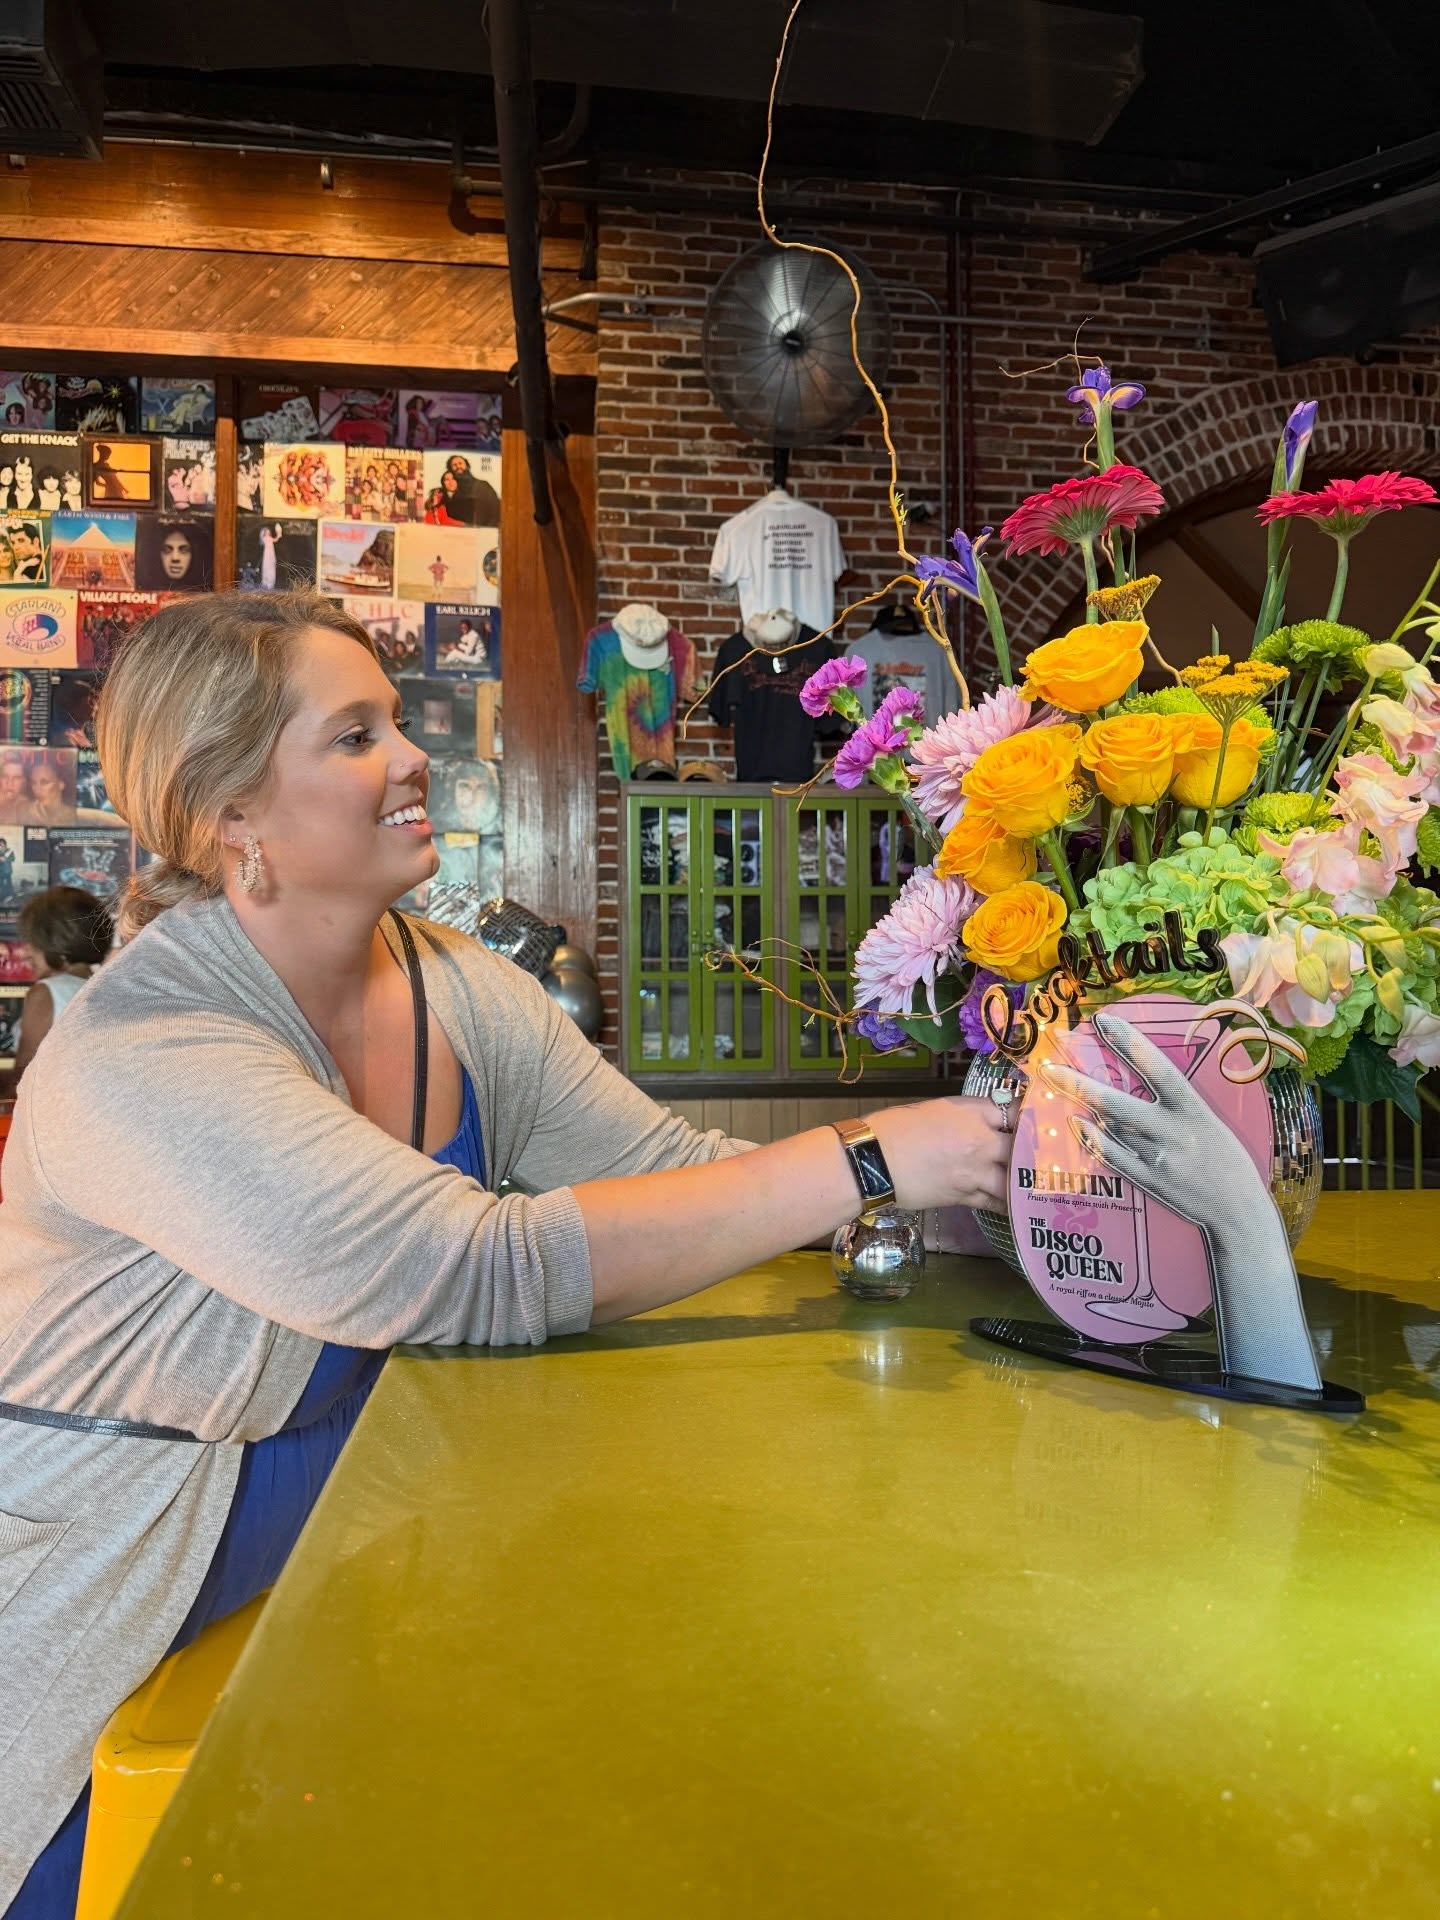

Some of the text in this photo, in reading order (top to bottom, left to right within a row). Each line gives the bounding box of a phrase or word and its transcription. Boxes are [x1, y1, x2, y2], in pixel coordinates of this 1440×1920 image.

[1, 433, 78, 446] GET THE KNACK
[79, 591, 158, 604] VILLAGE PEOPLE
[1017, 1167, 1124, 1199] BETHTINI
[1027, 1192, 1048, 1204] Fruity
[1049, 1196, 1071, 1205] vodka
[1092, 1201, 1110, 1210] with
[1110, 1202, 1143, 1214] Prosecco
[1028, 1216, 1047, 1228] THE
[1030, 1227, 1104, 1257] DISCO
[1045, 1251, 1124, 1284] QUEEN
[1048, 1283, 1055, 1291] A
[1056, 1286, 1075, 1295] royal
[1076, 1288, 1089, 1298] riff
[1104, 1293, 1129, 1304] classic
[1130, 1297, 1155, 1309] Mojito
